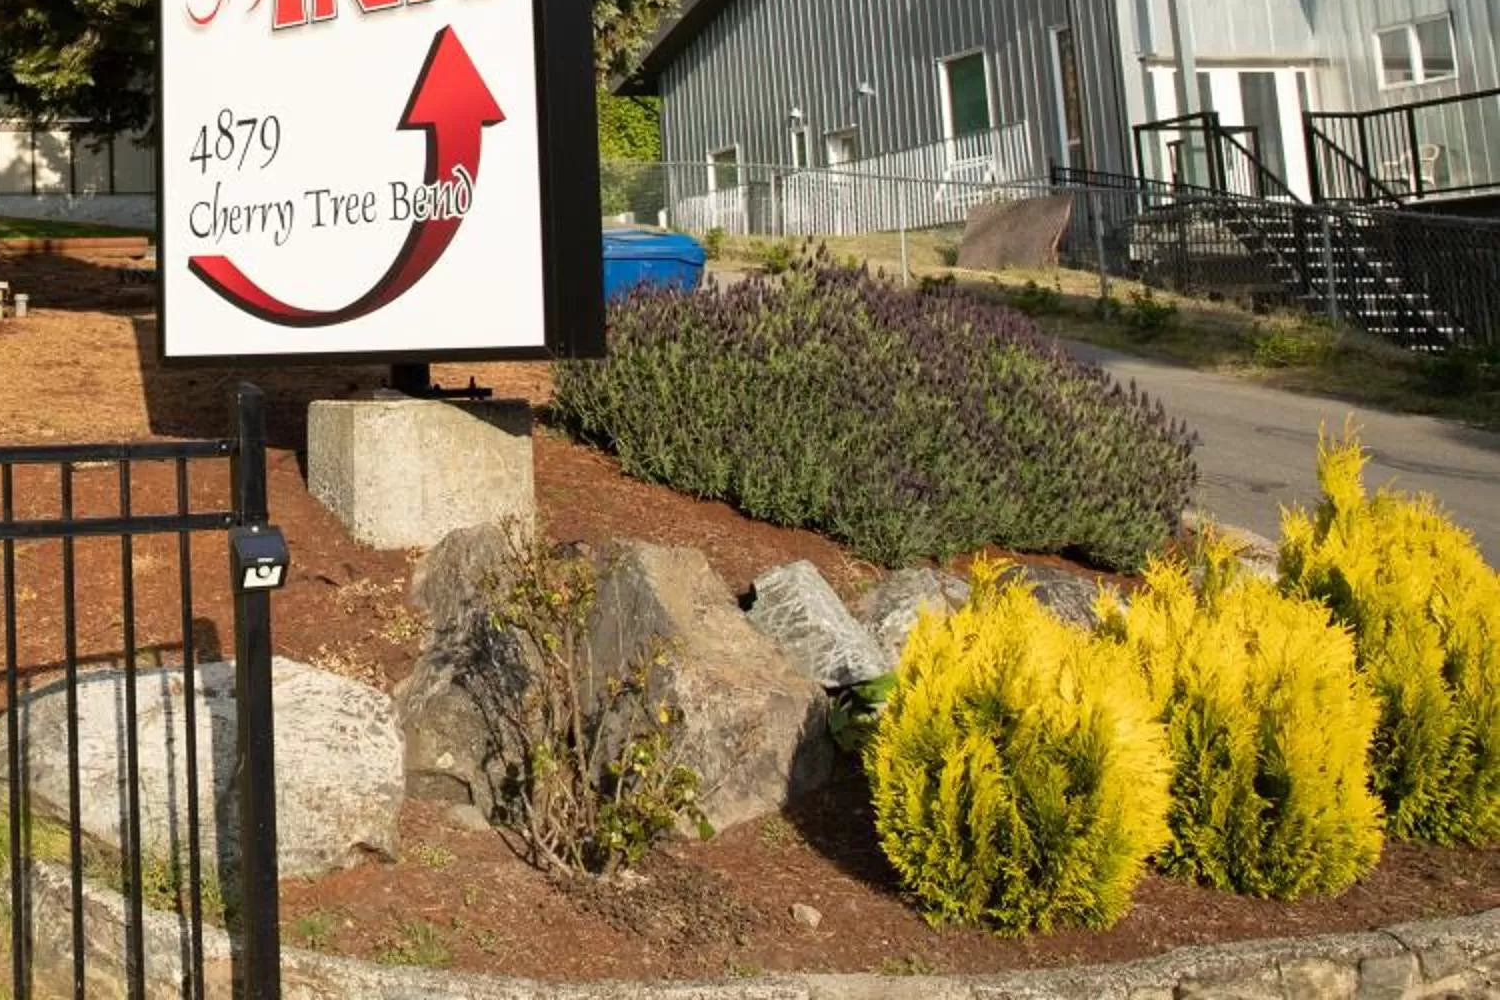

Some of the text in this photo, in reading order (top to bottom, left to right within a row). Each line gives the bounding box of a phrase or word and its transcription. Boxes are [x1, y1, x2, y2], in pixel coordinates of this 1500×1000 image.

[189, 108, 281, 174] 4879
[189, 165, 475, 245] Cherry Tree Bend
